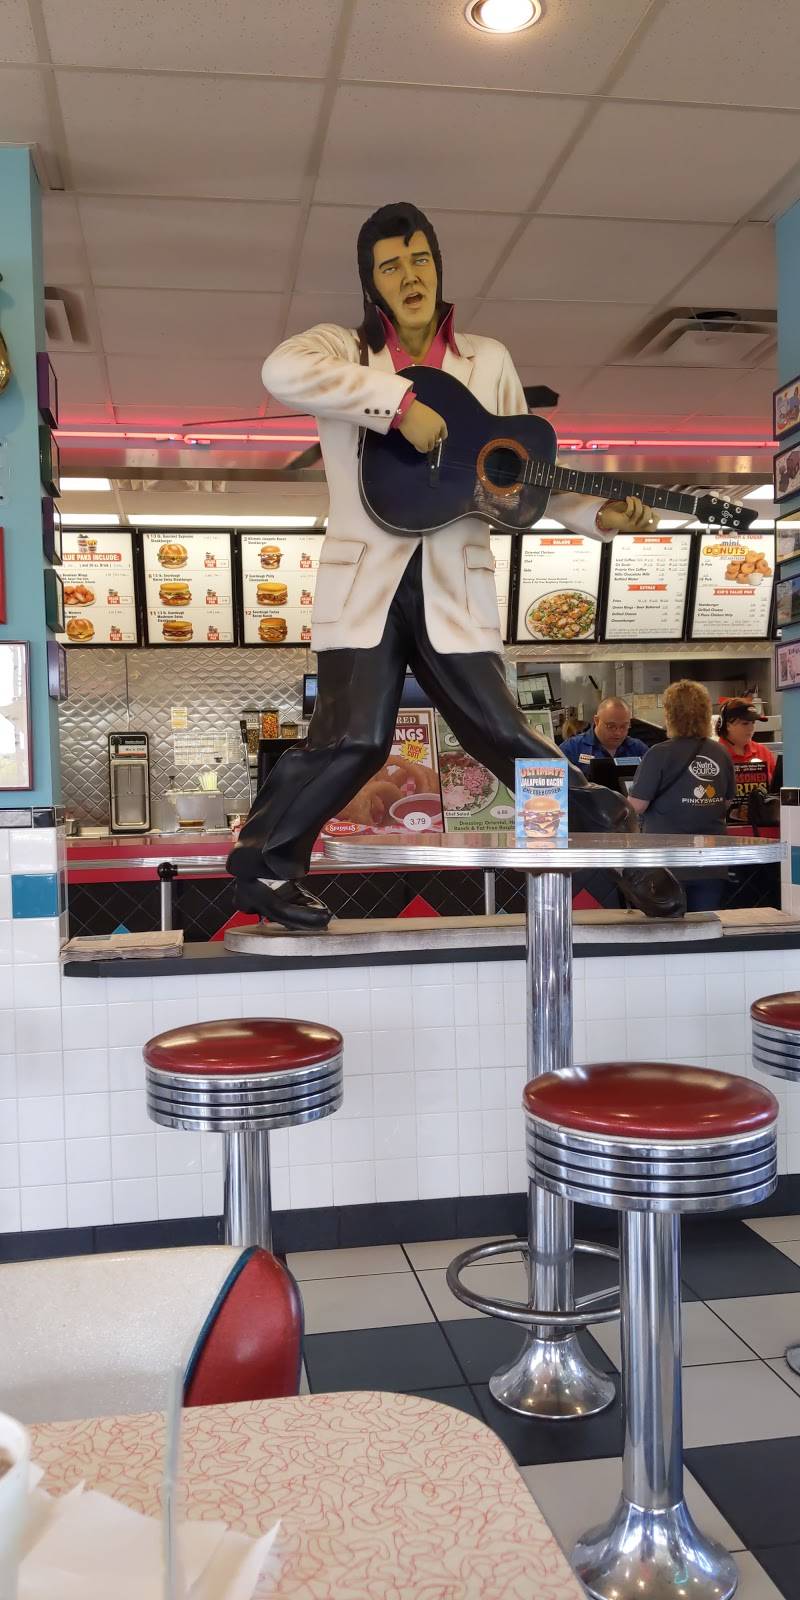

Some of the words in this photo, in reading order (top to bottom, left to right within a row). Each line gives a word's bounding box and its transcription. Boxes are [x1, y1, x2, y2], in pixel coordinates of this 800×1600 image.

[706, 546, 746, 555] DONUTS
[396, 716, 416, 724] RED
[521, 767, 565, 778] ULTIMATE
[692, 766, 716, 775] Source
[521, 777, 545, 786] JALAPEÑO
[546, 777, 564, 786] BACON
[736, 782, 768, 797] RIES
[330, 824, 356, 832] SPANGLES
